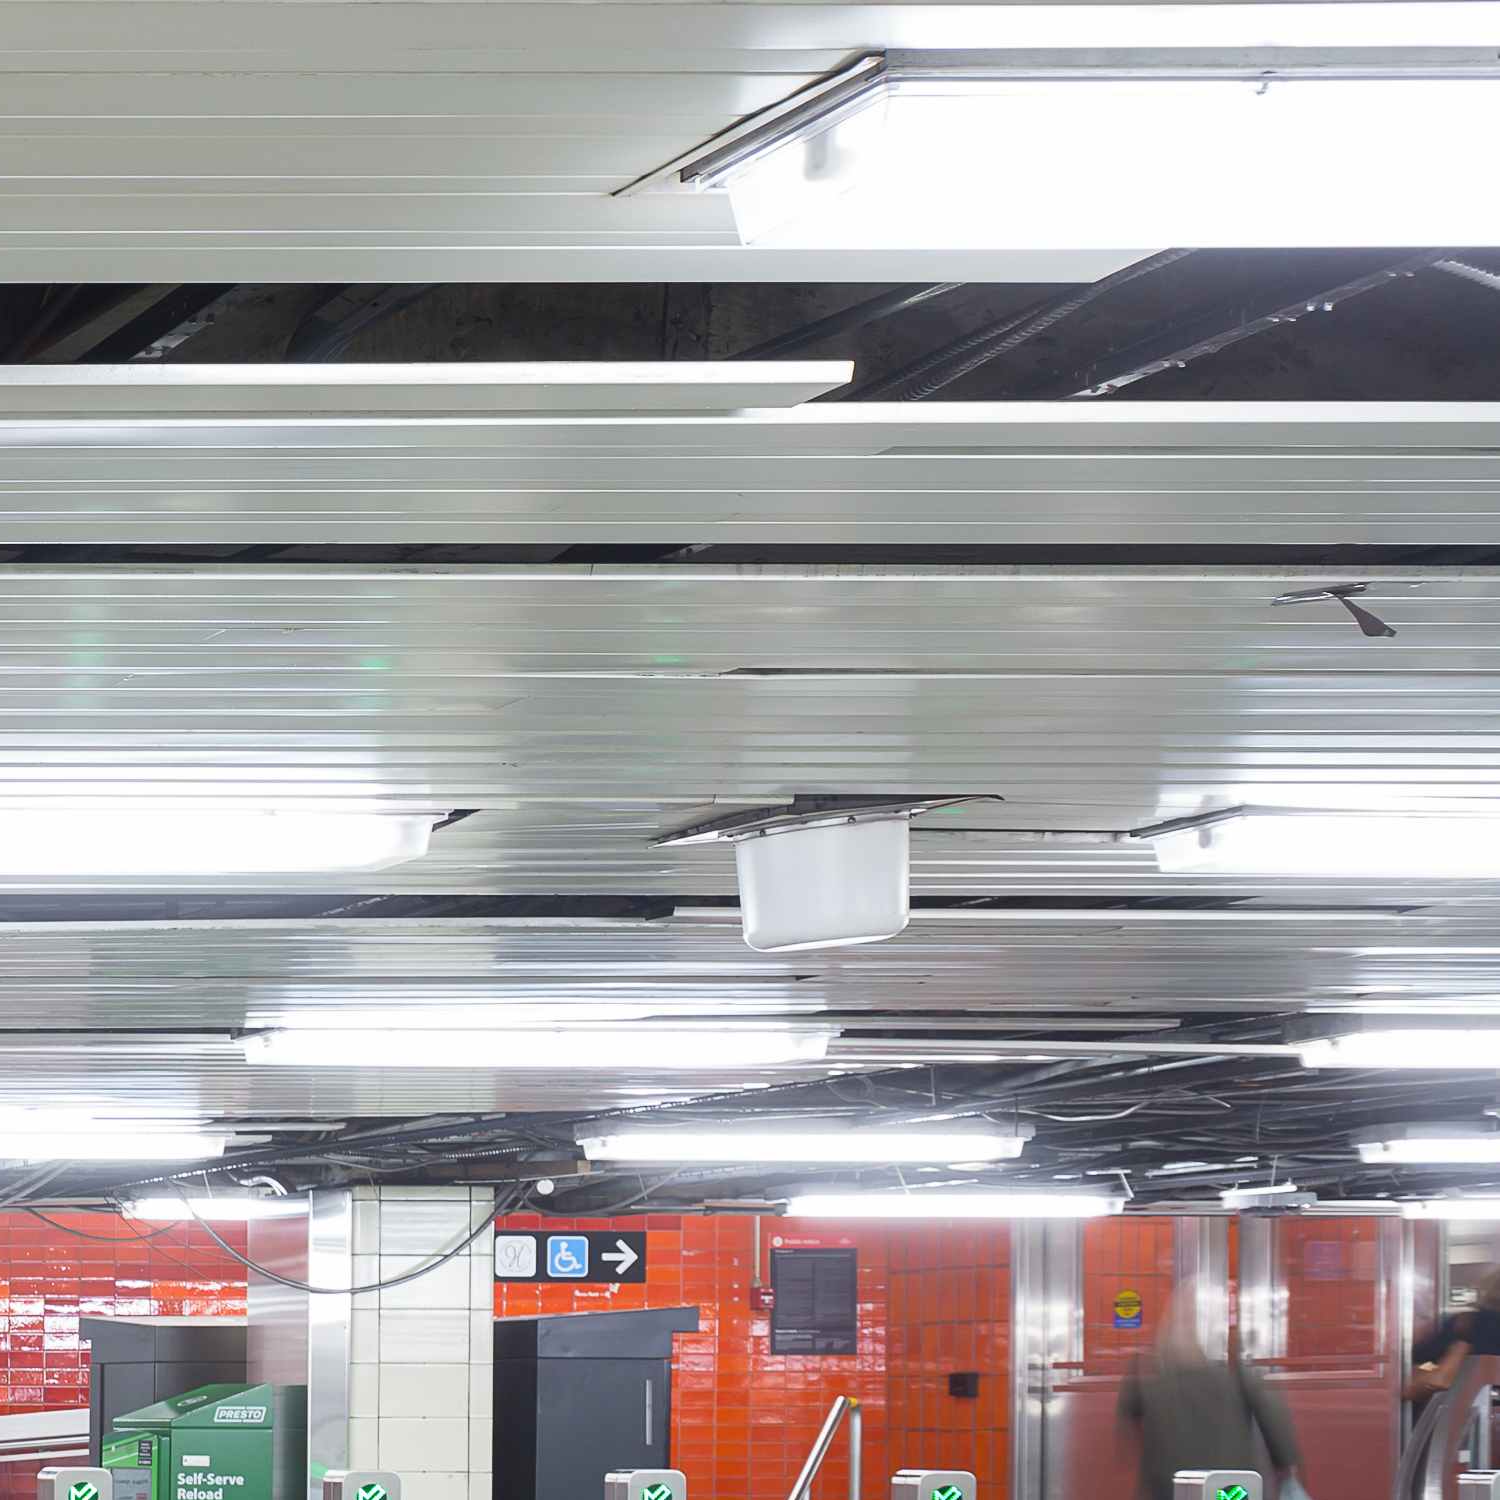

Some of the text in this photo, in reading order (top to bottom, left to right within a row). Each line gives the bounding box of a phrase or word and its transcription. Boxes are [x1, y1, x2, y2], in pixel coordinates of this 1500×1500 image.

[218, 1410, 262, 1420] PRESTO
[177, 1472, 245, 1486] Self-Serve
[177, 1487, 223, 1500] Reload
